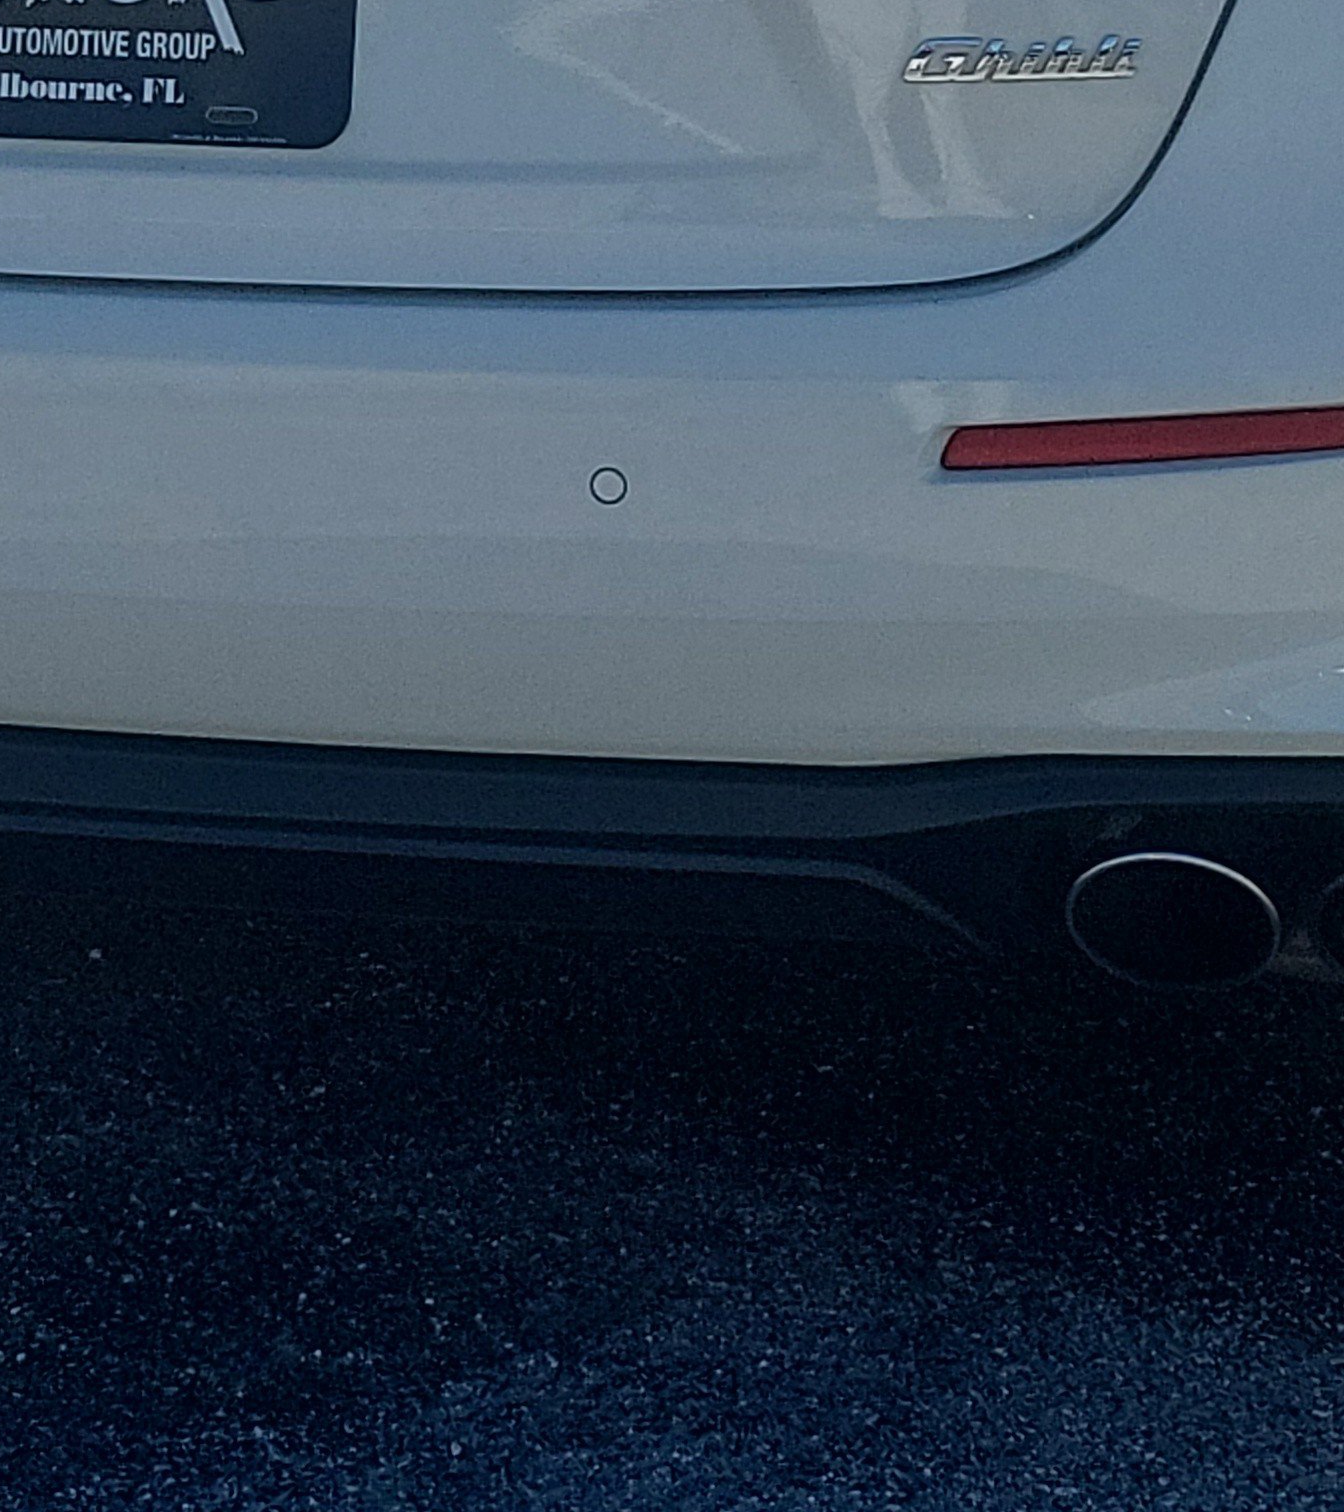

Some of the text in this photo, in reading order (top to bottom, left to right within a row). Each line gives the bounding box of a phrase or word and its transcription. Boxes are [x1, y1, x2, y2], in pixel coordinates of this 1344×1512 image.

[136, 31, 216, 60] GROUP
[903, 34, 1143, 83] Ghibli
[142, 77, 185, 104] FL
